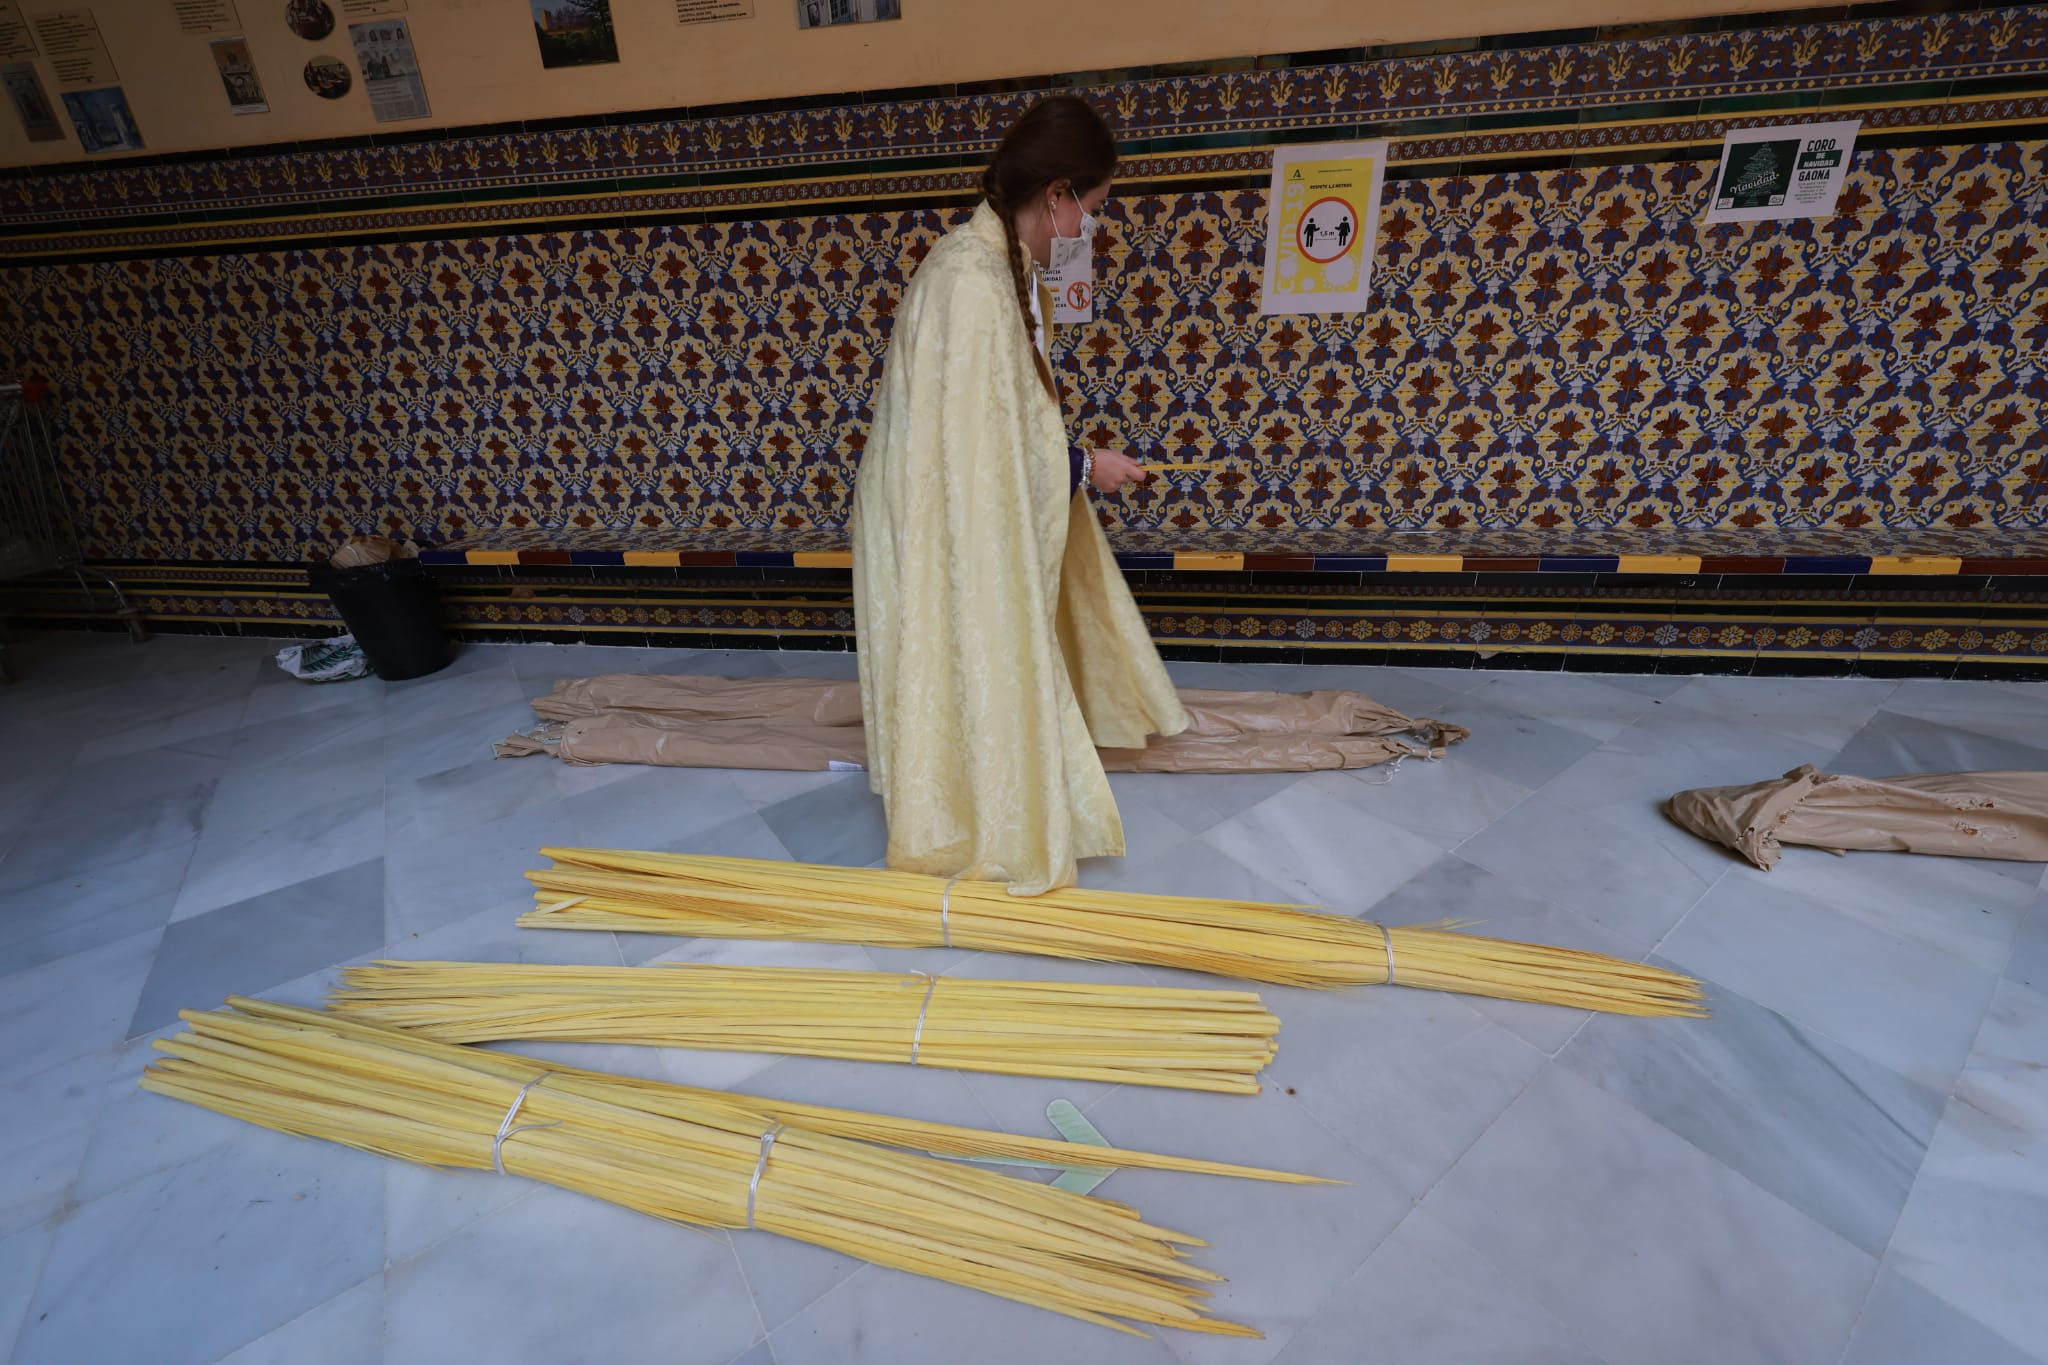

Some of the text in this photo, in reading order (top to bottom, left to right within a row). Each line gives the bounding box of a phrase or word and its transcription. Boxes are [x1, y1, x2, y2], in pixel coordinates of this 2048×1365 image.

[1807, 139, 1836, 151] CORO
[1804, 160, 1835, 168] NAVIDAD
[1798, 169, 1830, 181] GAONA
[1729, 170, 1777, 194] Navidad
